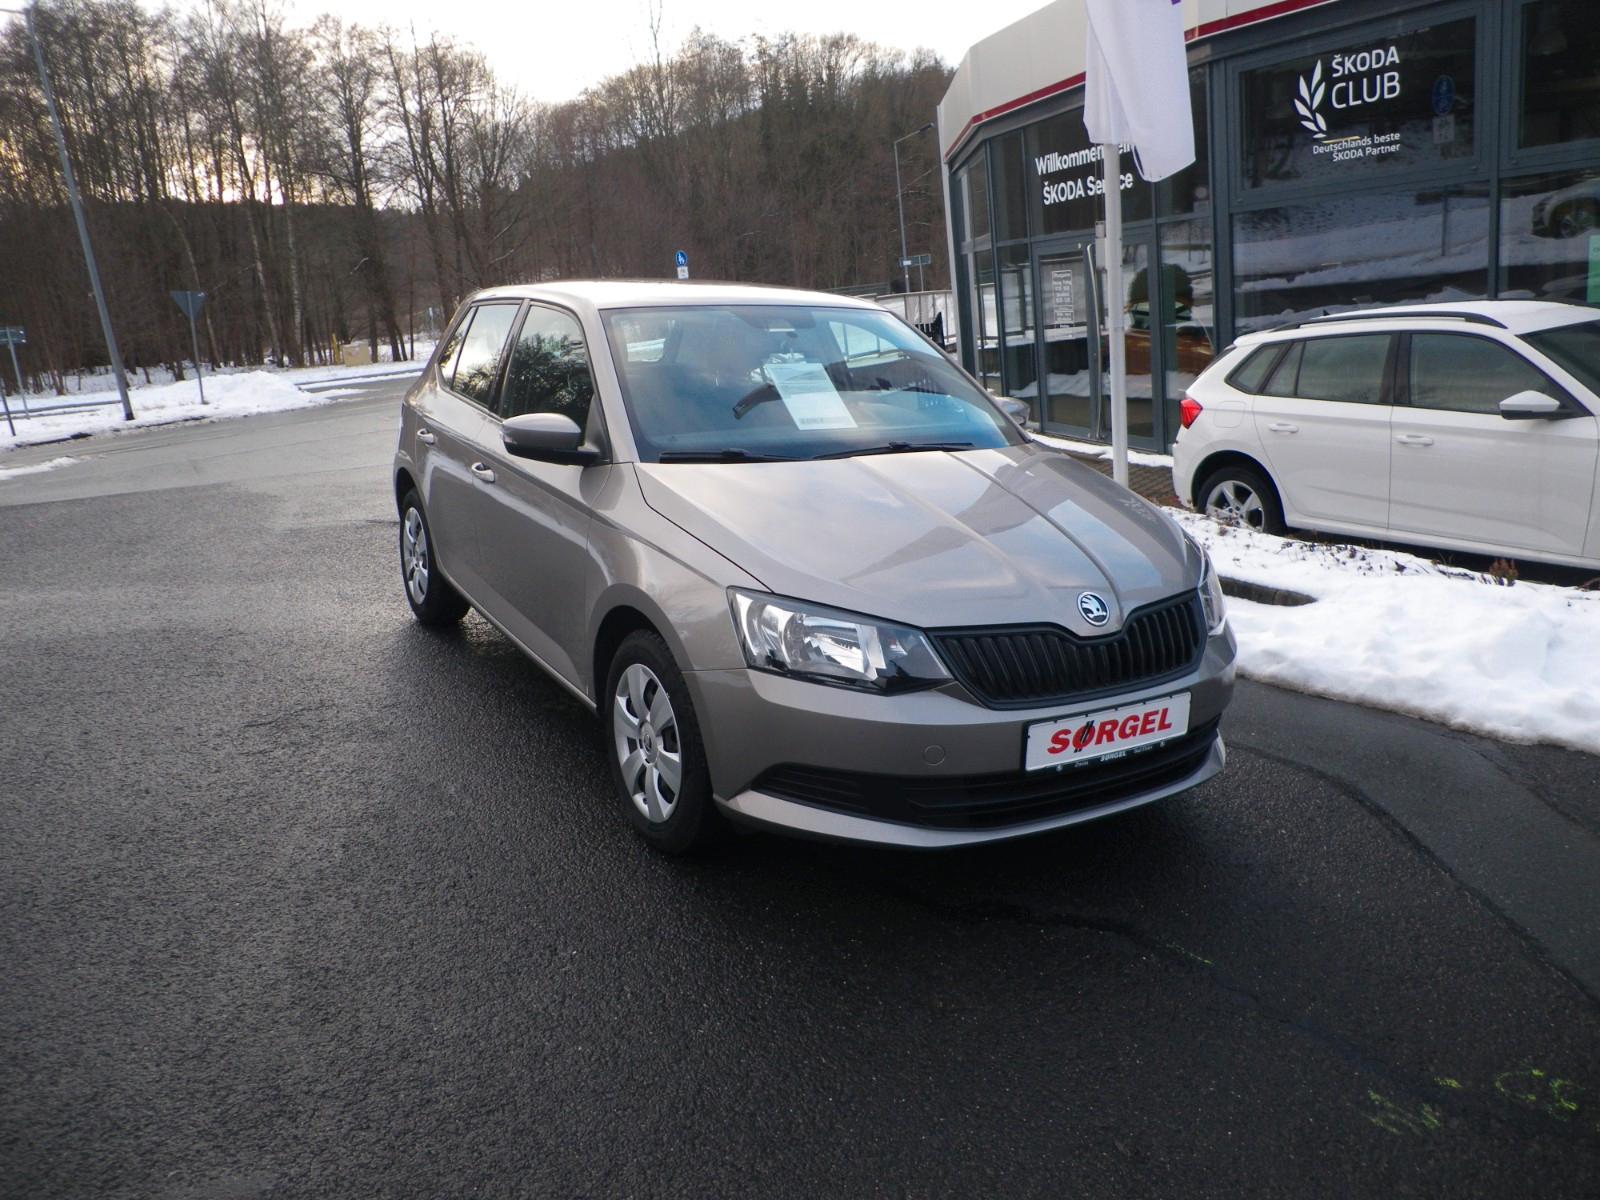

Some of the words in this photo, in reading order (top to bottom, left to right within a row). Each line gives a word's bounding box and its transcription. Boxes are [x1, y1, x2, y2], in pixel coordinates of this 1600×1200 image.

[1332, 46, 1400, 77] ŠKODA
[1332, 71, 1400, 109] CLUB
[1313, 136, 1372, 154] Deutschlands
[1374, 132, 1400, 144] beste
[1333, 148, 1364, 162] ŠKODA
[1366, 143, 1401, 156] Partner
[1035, 144, 1104, 176] Willkommen
[1043, 178, 1085, 206] ŠKODA
